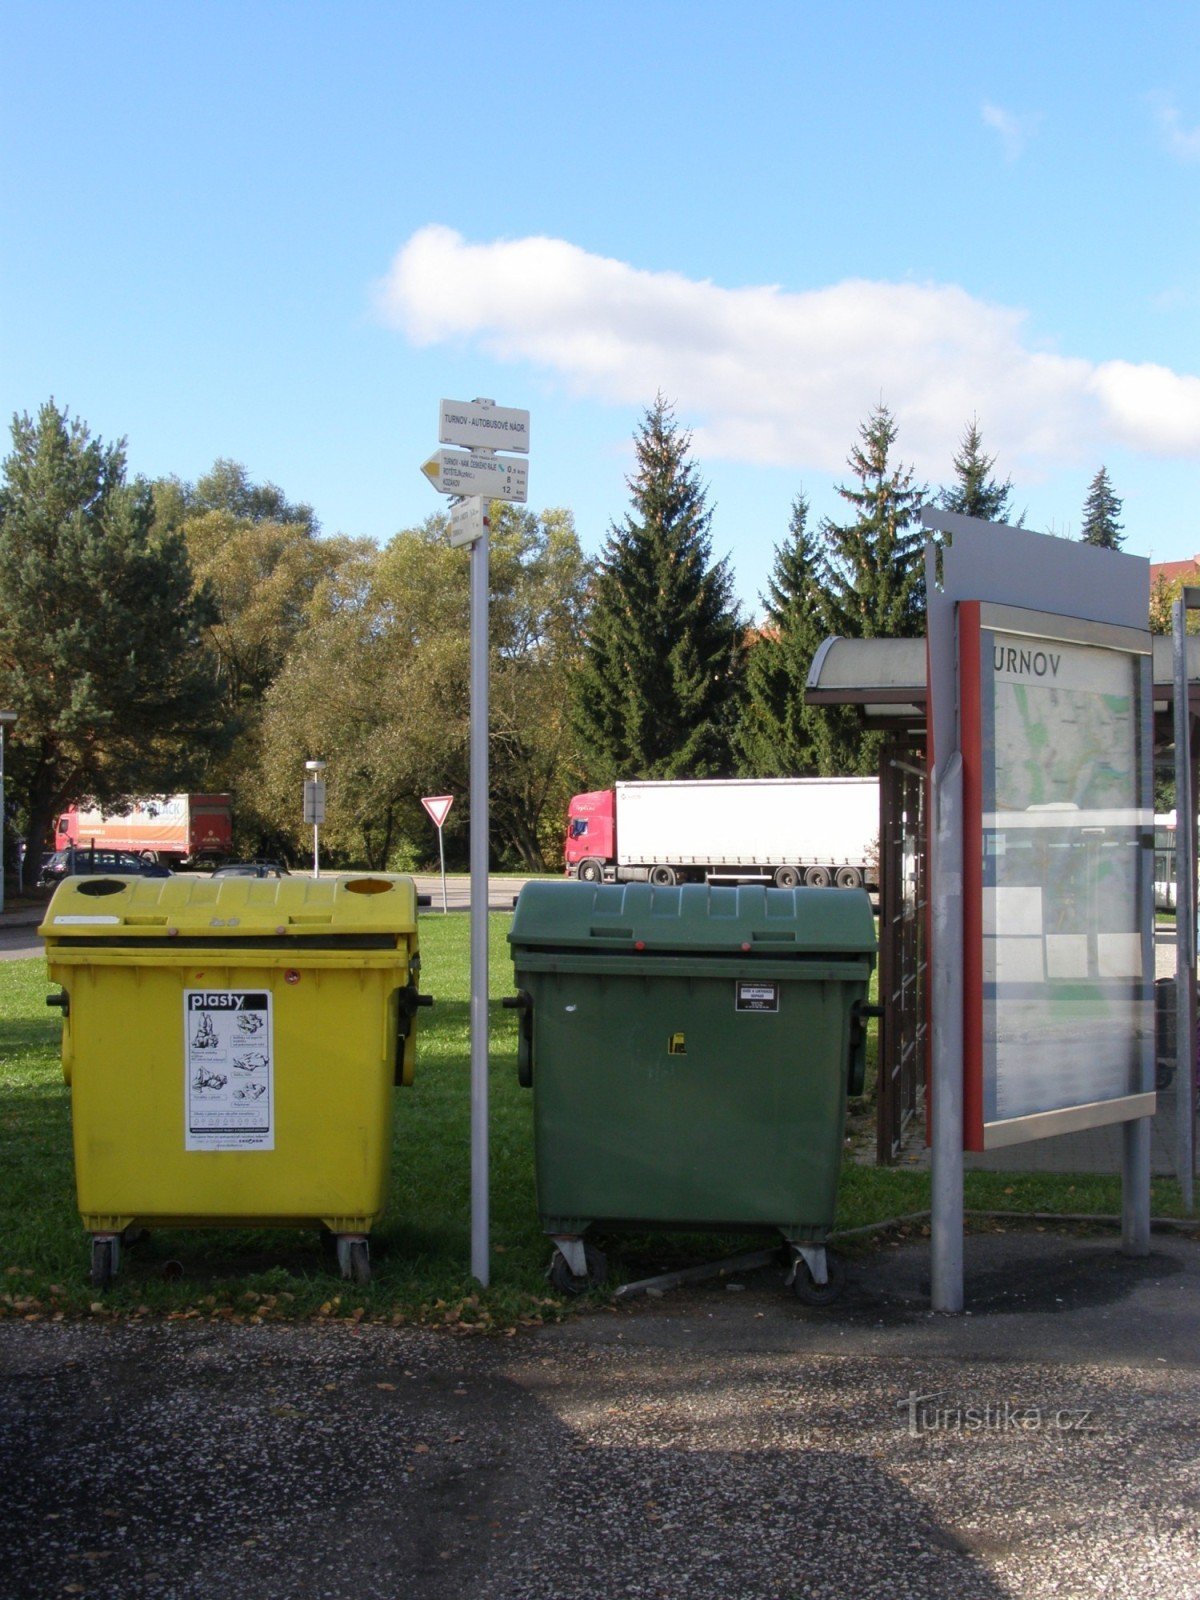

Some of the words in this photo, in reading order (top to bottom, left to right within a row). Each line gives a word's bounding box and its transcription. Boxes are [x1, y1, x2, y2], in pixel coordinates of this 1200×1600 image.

[445, 414, 467, 425] TURNOV
[471, 417, 508, 431] AUTOBUSOVÉ
[509, 421, 526, 433] NÁDR.
[517, 467, 526, 475] km
[502, 485, 511, 494] 12
[191, 993, 245, 1011] plasty
